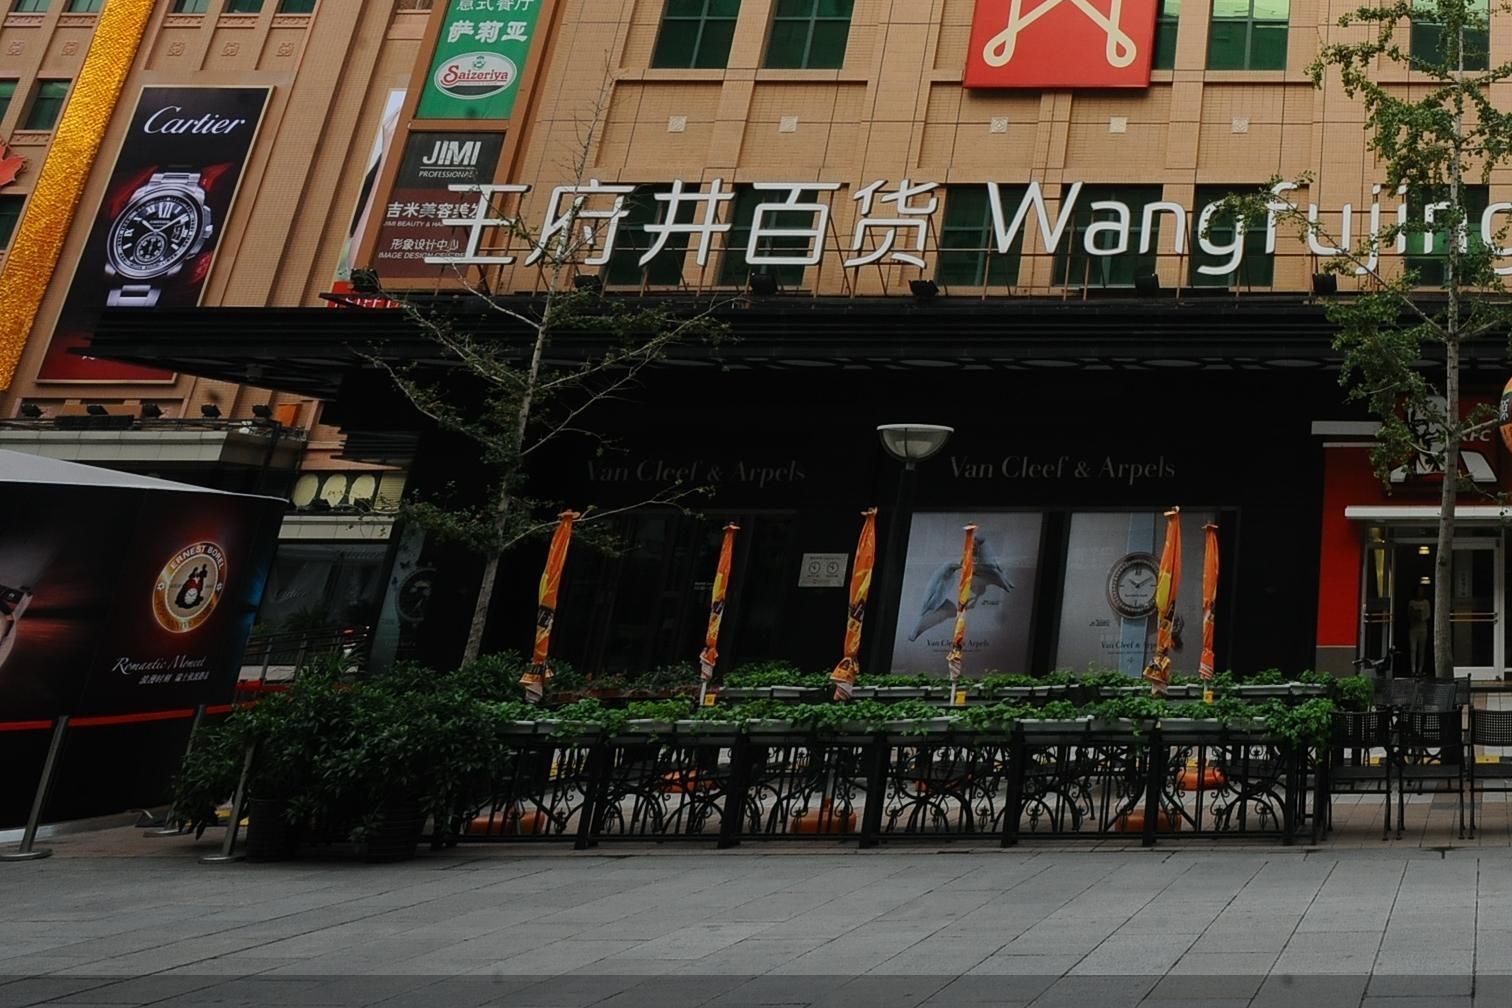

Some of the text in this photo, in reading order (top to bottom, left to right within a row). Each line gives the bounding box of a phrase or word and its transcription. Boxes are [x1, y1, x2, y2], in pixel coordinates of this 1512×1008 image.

[448, 20, 528, 43] 萨莉亚
[440, 65, 508, 87] Saizeriya
[144, 106, 246, 134] Cartier
[422, 141, 482, 165] JIMI
[424, 178, 940, 269] 王府井百货
[636, 459, 702, 481] Cleef
[732, 459, 806, 488] Arpels
[950, 455, 1176, 486] Van Cleef & Arpels
[170, 544, 225, 570] ERNEST BOREL
[112, 656, 167, 675] Romantic
